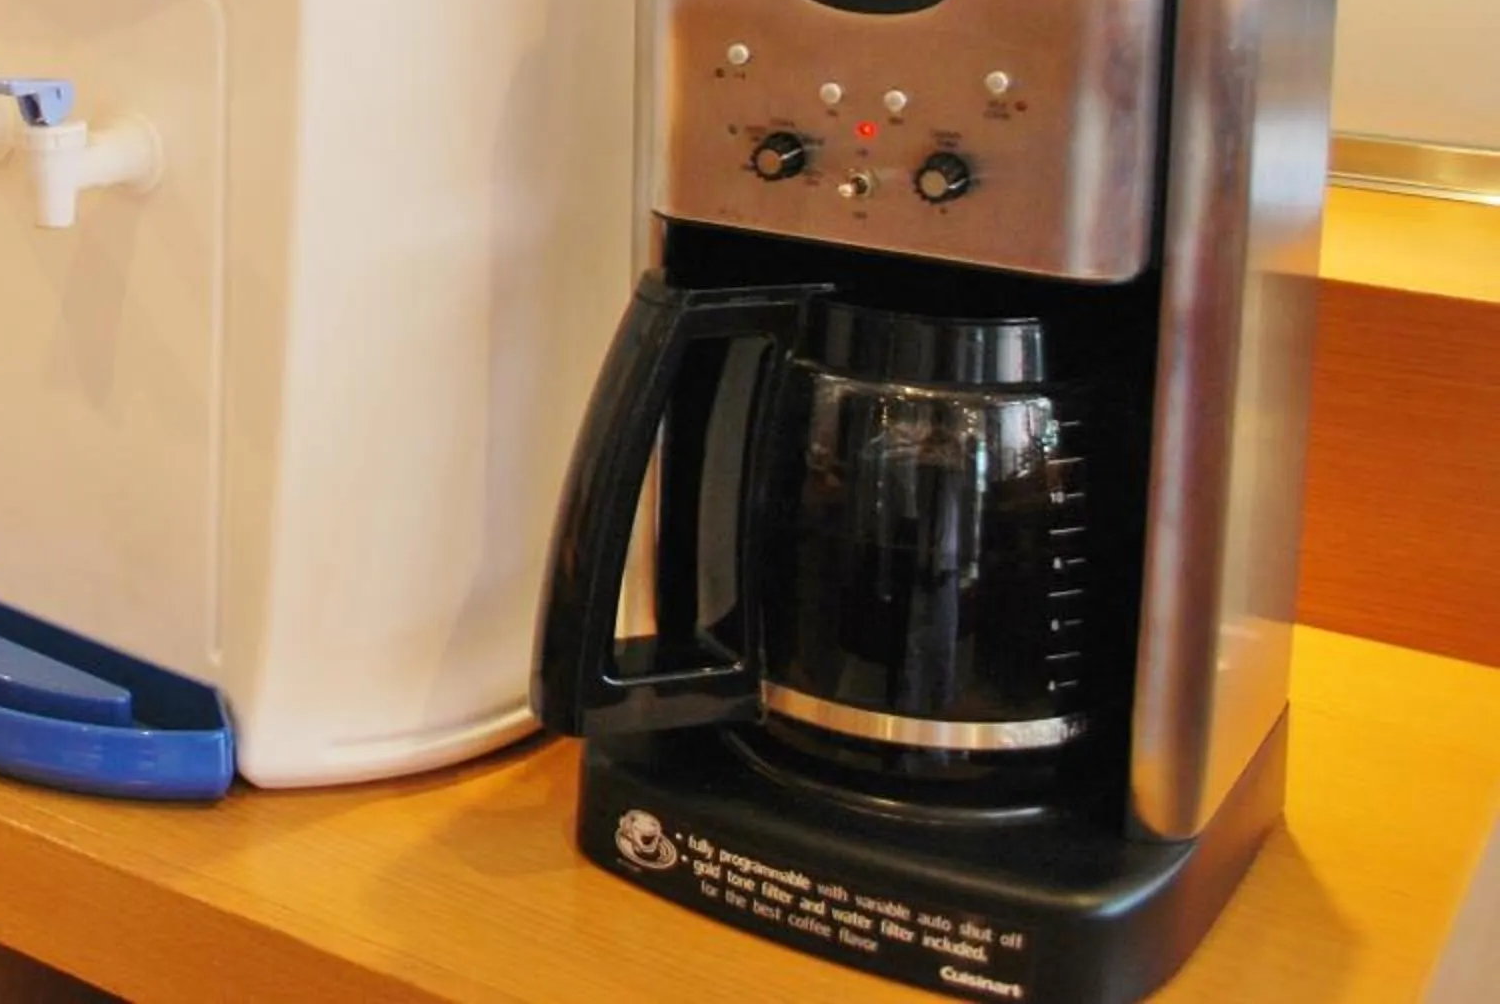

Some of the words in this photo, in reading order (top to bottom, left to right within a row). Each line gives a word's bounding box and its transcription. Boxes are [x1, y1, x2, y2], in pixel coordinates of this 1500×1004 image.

[688, 834, 715, 859] fully
[817, 883, 849, 902] with
[917, 911, 953, 932] auto
[958, 920, 994, 944] shut
[999, 931, 1024, 950] off
[693, 859, 722, 880] gold
[727, 870, 756, 892] tone
[761, 881, 795, 905] filter
[799, 896, 826, 916] and
[831, 907, 873, 930] water
[880, 918, 916, 943] filter
[701, 879, 719, 898] for
[725, 888, 748, 910] the
[753, 898, 783, 922] best
[787, 913, 833, 938] coffee
[839, 926, 879, 953] flavor
[939, 964, 1025, 999] Cuisinart
